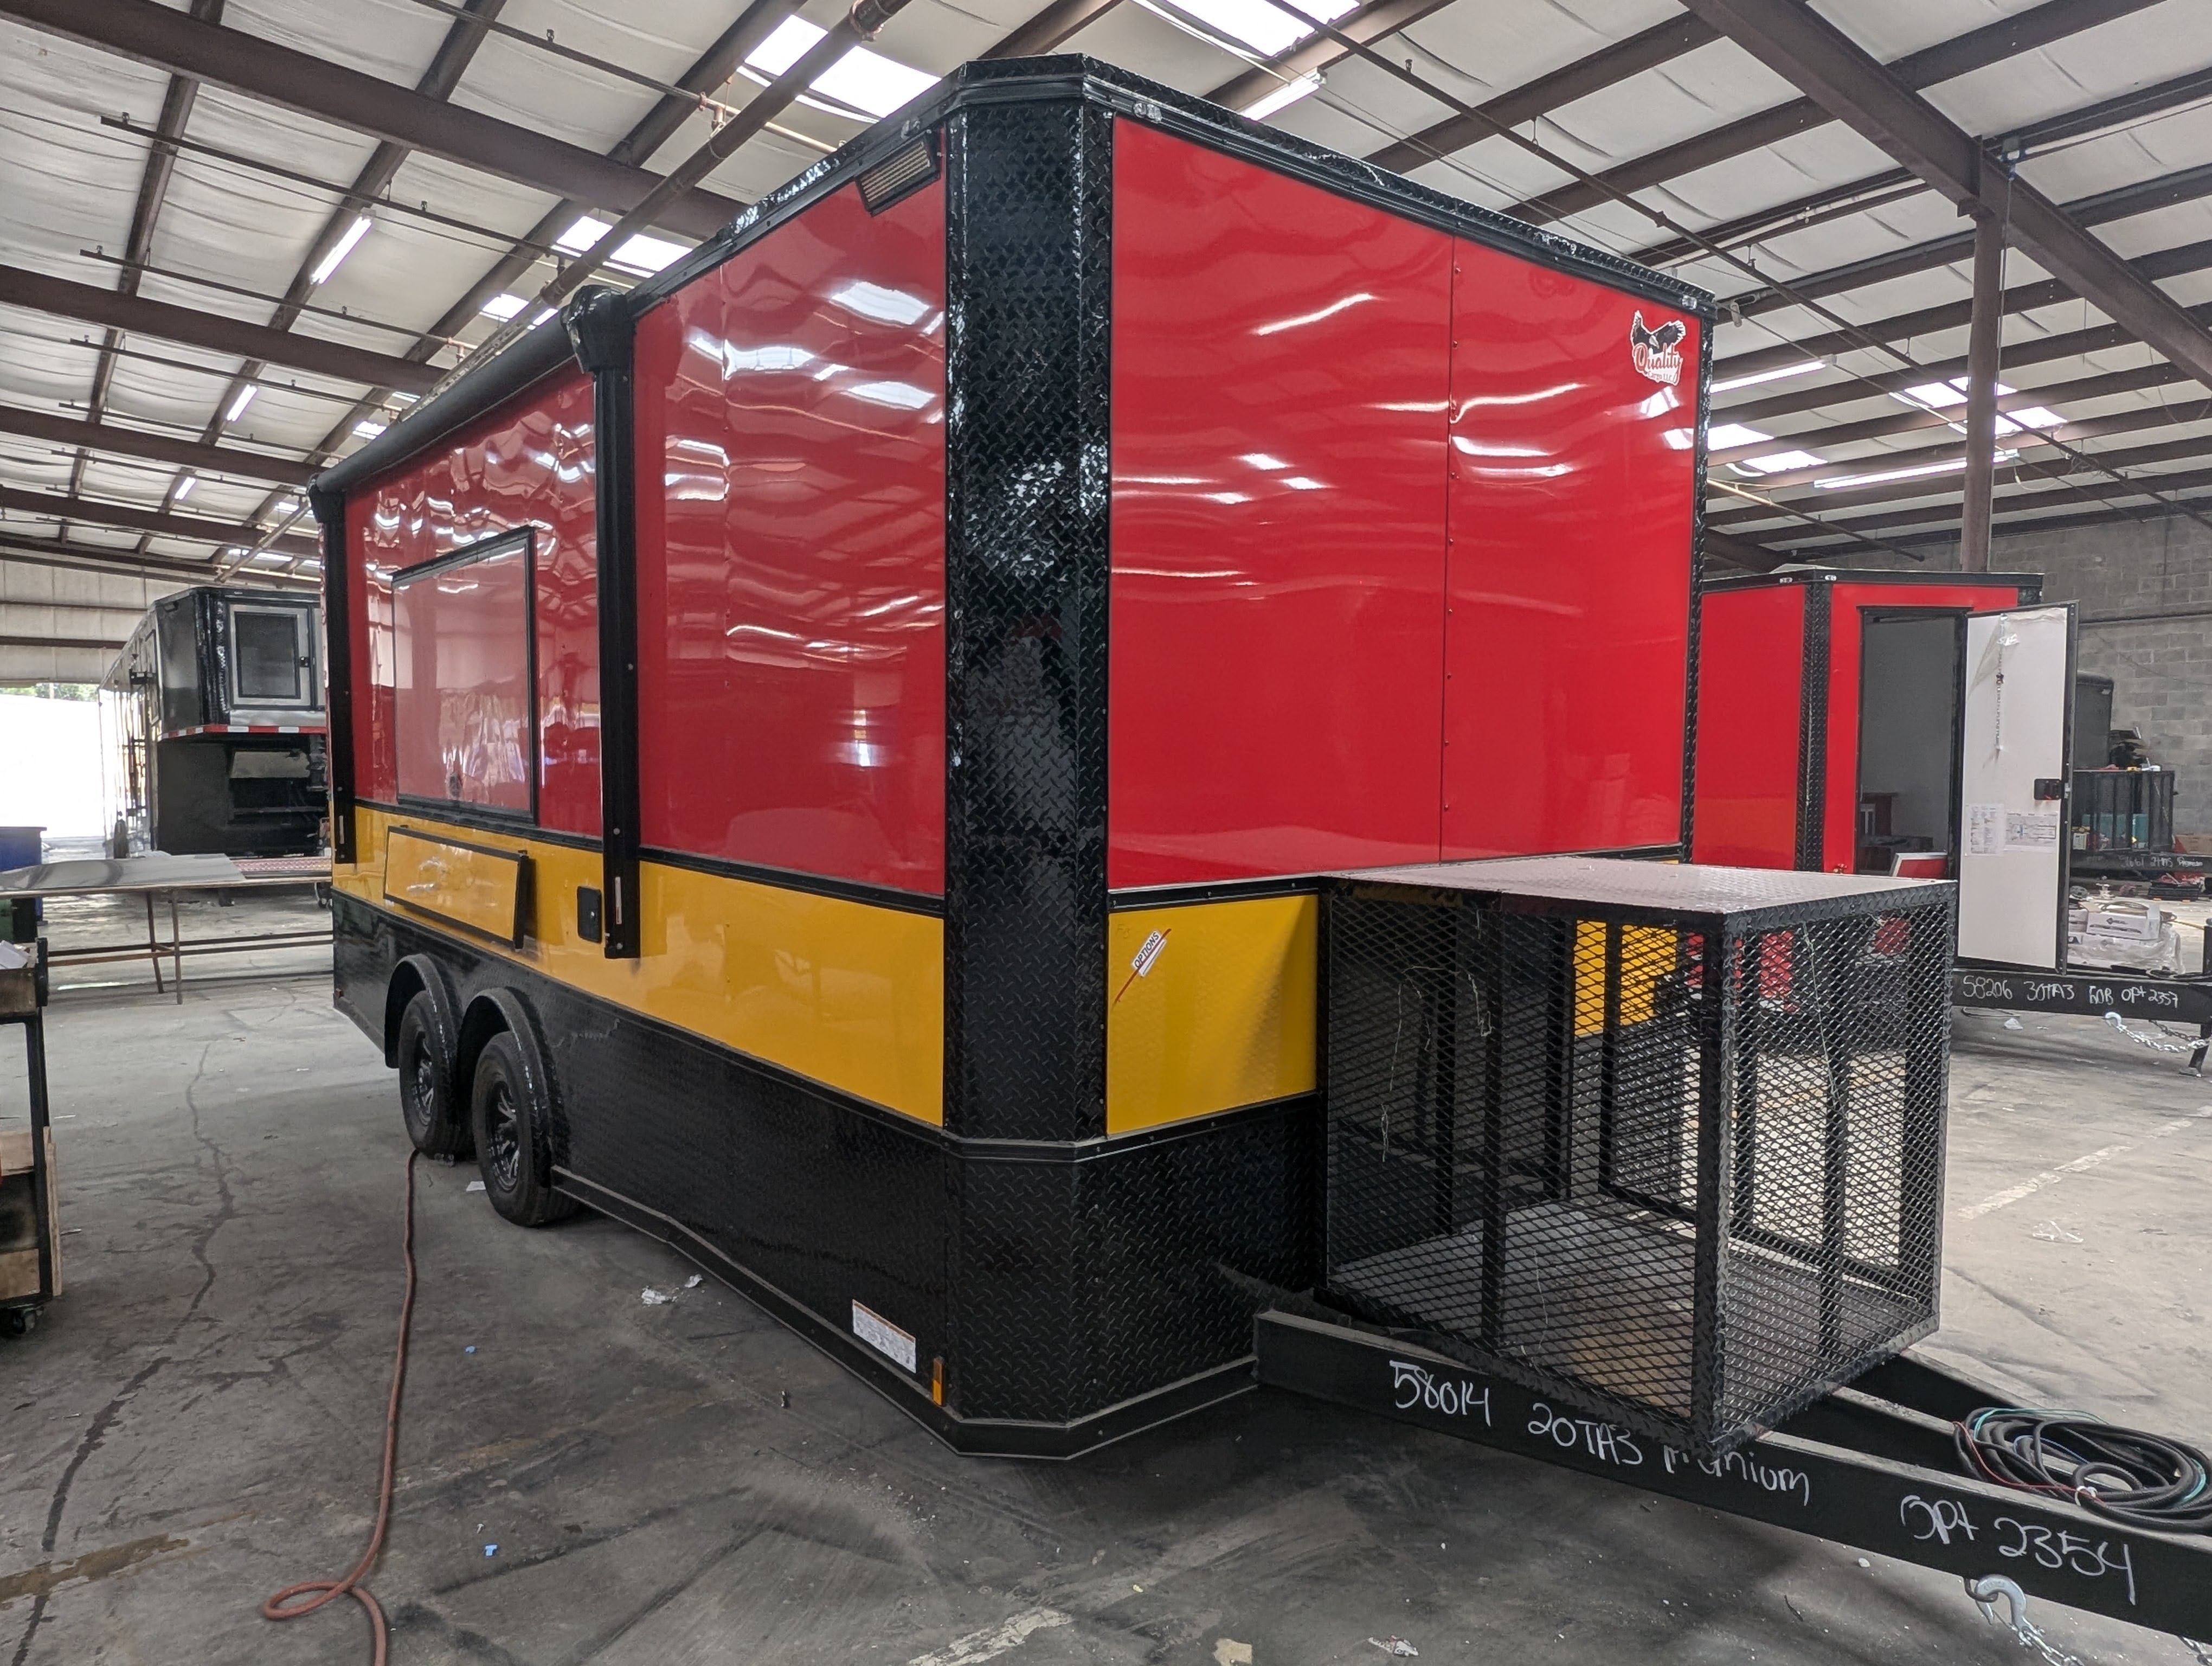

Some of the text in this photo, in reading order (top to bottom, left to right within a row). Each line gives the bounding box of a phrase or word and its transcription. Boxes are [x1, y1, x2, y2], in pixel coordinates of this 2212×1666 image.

[1633, 343, 1683, 386] Quality
[1134, 932, 1159, 968] OPTIONS
[1963, 975, 2012, 999] 58206
[2148, 989, 2178, 1009] 2357
[1389, 1360, 1491, 1427] 58014
[1527, 1402, 1643, 1465] 20TA3
[1993, 1517, 2136, 1606] 2354
